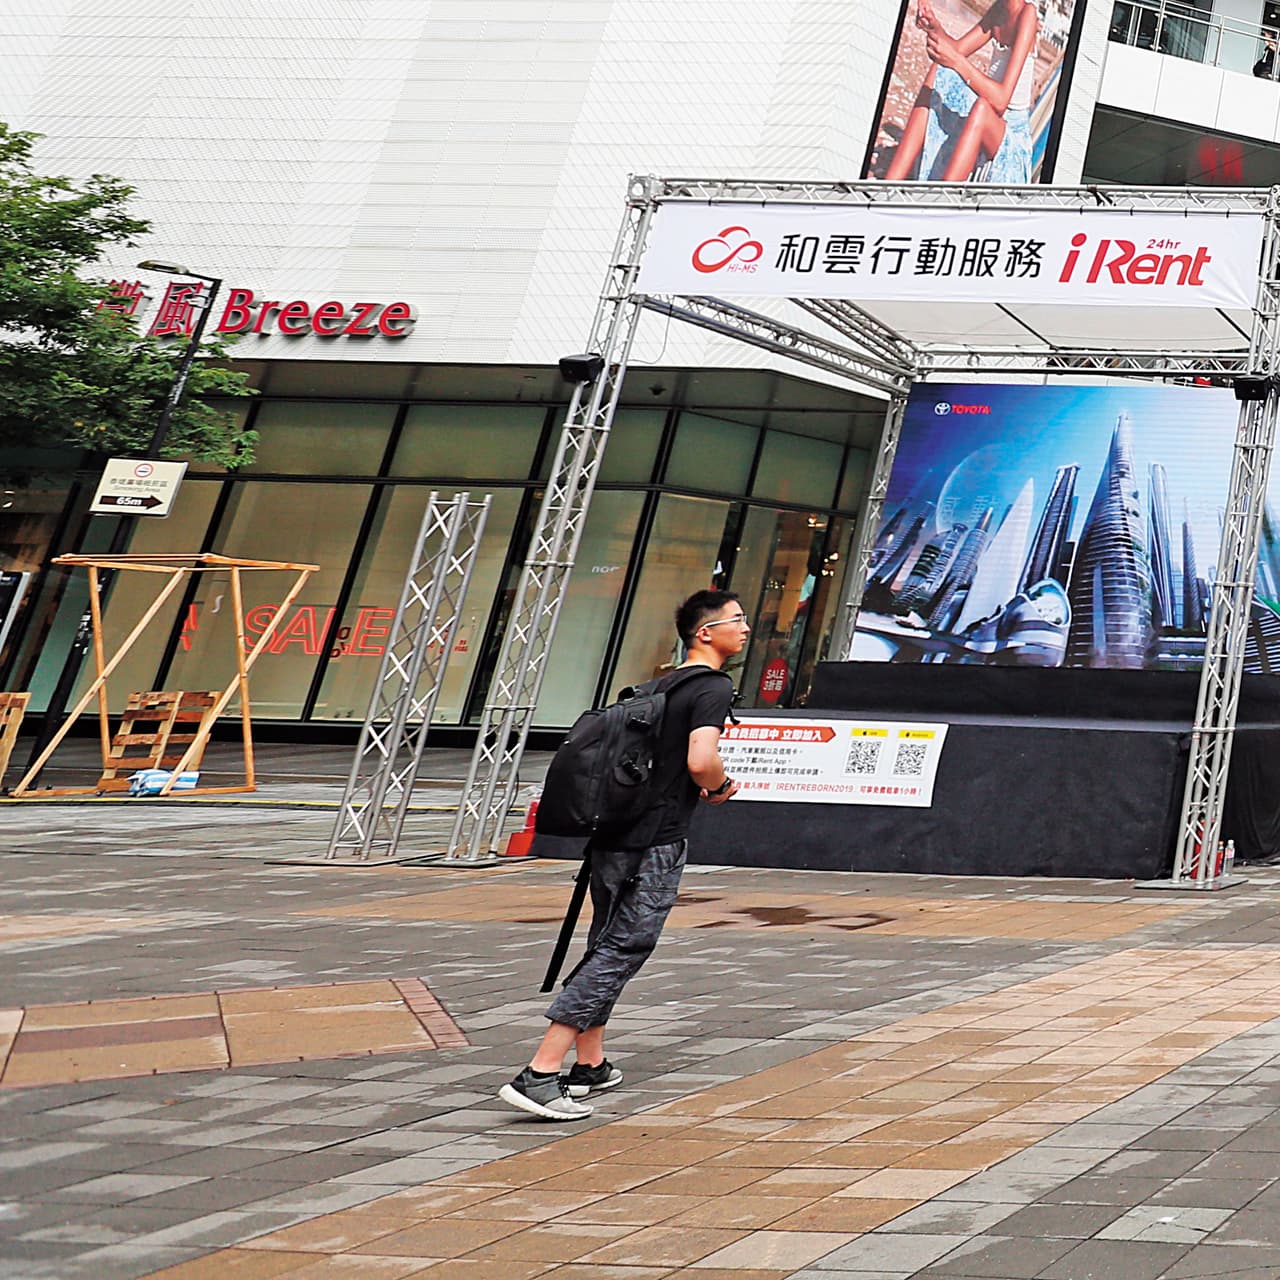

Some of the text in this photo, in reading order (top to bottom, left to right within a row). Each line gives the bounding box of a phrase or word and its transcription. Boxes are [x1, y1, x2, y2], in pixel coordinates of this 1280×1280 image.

[1146, 238, 1182, 250] 24hr
[775, 234, 1047, 278] 和雲行動服務
[215, 288, 413, 336] Breeze
[951, 404, 992, 415] TOYOTA
[116, 496, 143, 506] 65m
[766, 668, 786, 679] SALE
